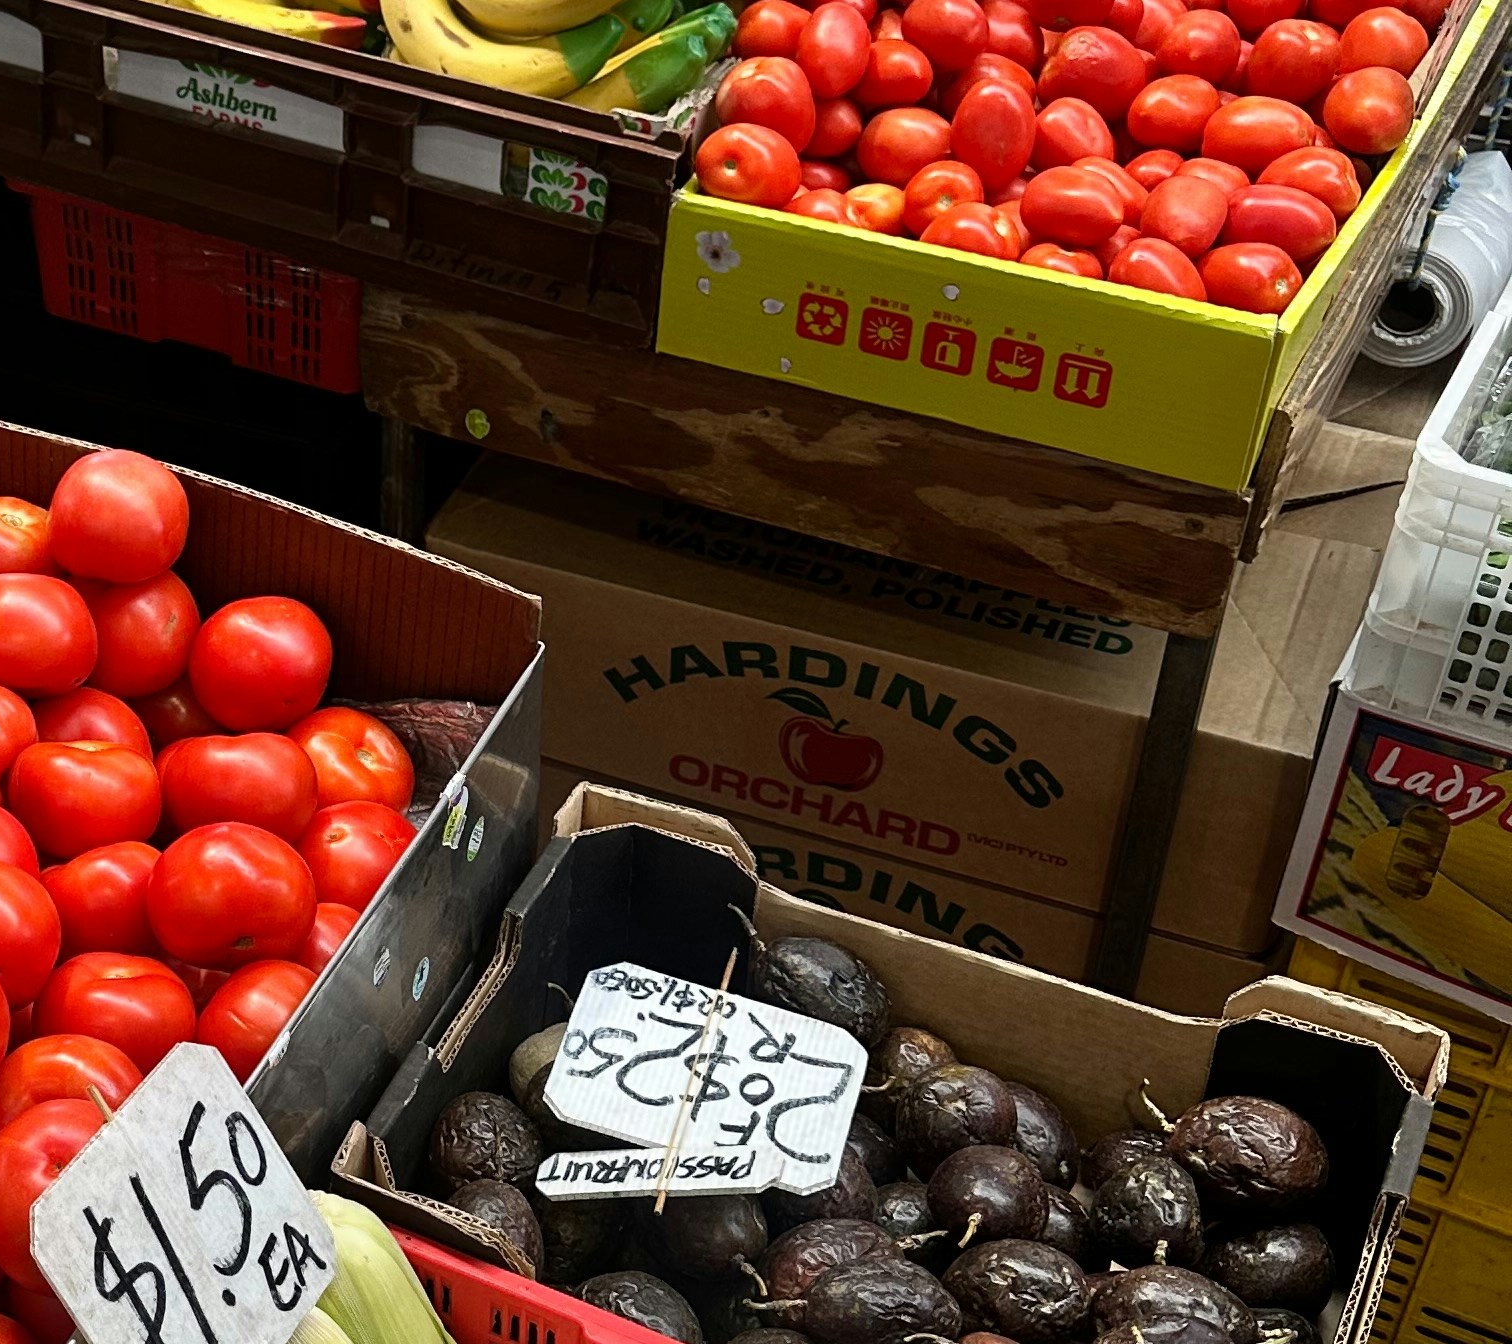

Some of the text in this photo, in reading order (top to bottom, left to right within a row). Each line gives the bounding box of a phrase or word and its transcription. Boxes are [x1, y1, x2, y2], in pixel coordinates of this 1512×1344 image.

[176, 76, 278, 122] Ashbern
[870, 578, 1135, 655] POLISHED
[603, 640, 1065, 810] HARDINGS
[668, 754, 960, 857] ORCHARD
[1374, 746, 1498, 821] Lady
[1037, 851, 1069, 868] LTD
[562, 1012, 740, 1123] $2.50
[766, 1054, 854, 1164] 2
[265, 1222, 327, 1313] EA
